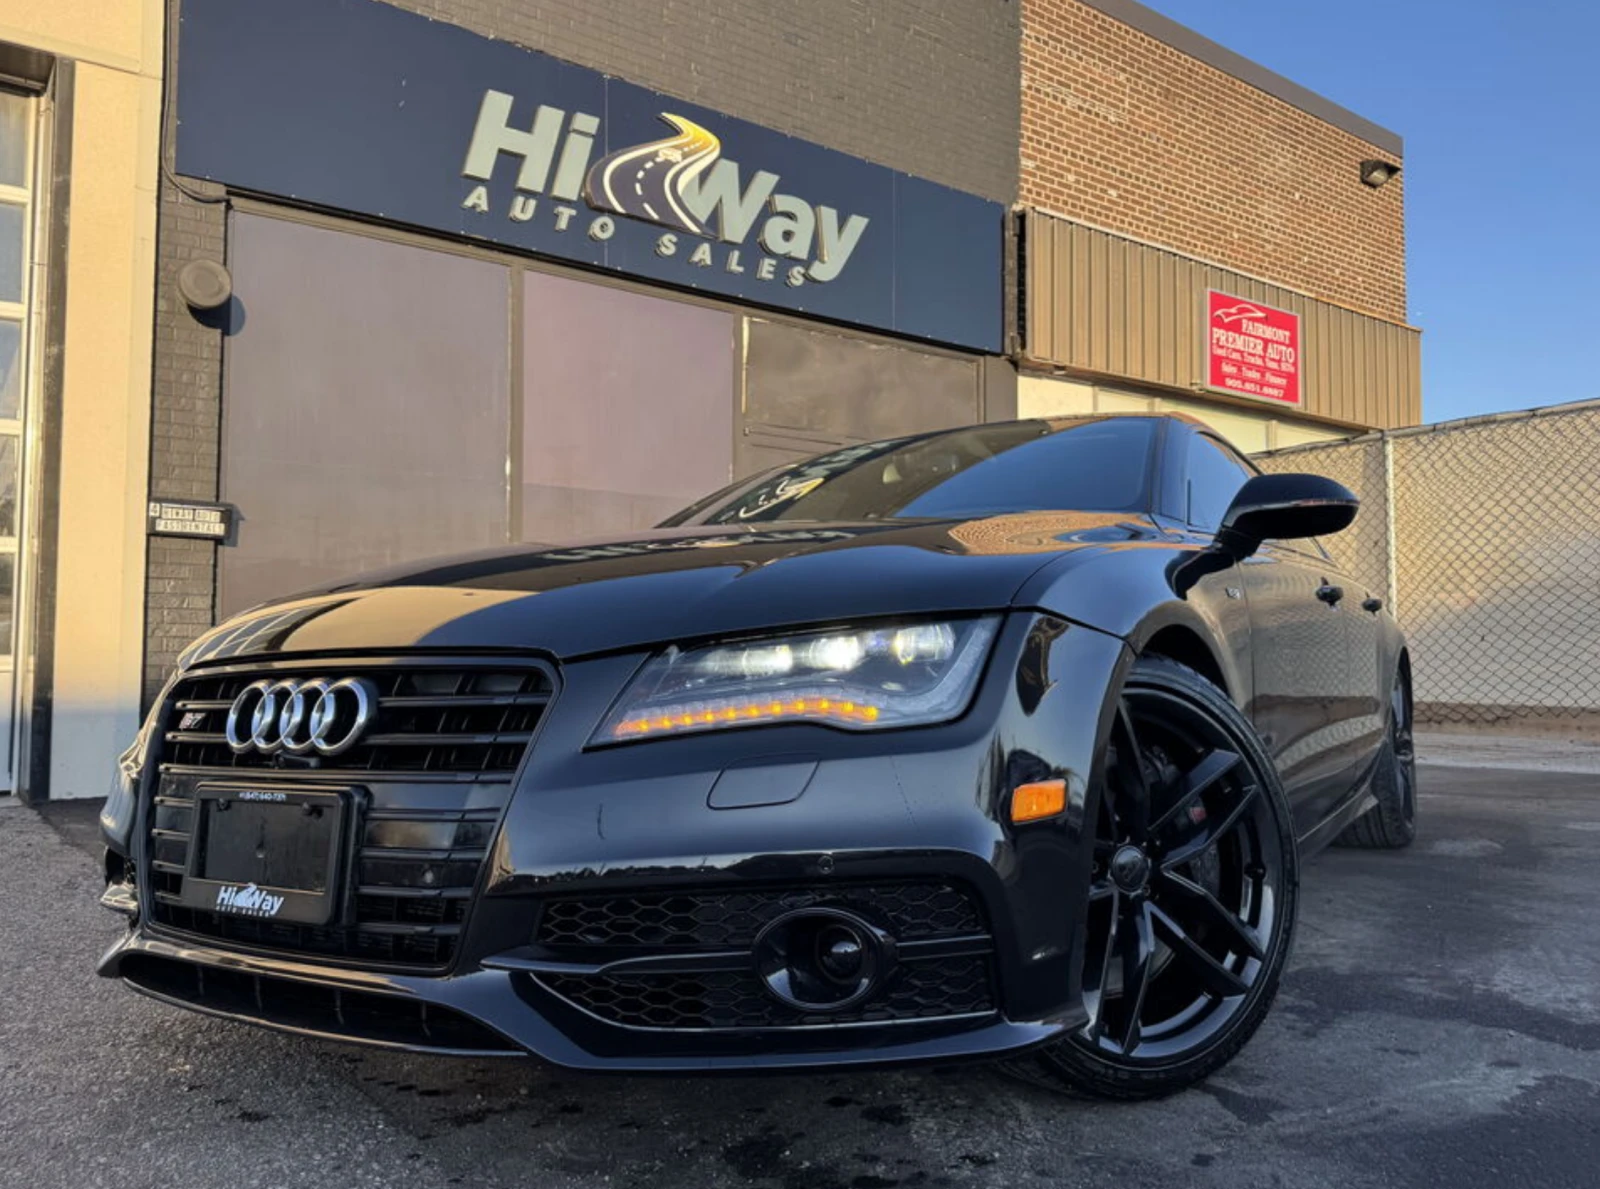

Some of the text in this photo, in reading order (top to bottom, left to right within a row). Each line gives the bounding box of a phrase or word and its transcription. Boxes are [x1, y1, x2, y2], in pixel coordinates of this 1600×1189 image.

[462, 89, 870, 283] Hi Way
[462, 186, 807, 288] AUTO SALES
[1211, 327, 1264, 356] PREMIER
[1265, 342, 1295, 363] AUTO
[1241, 318, 1290, 344] FAIRMONT
